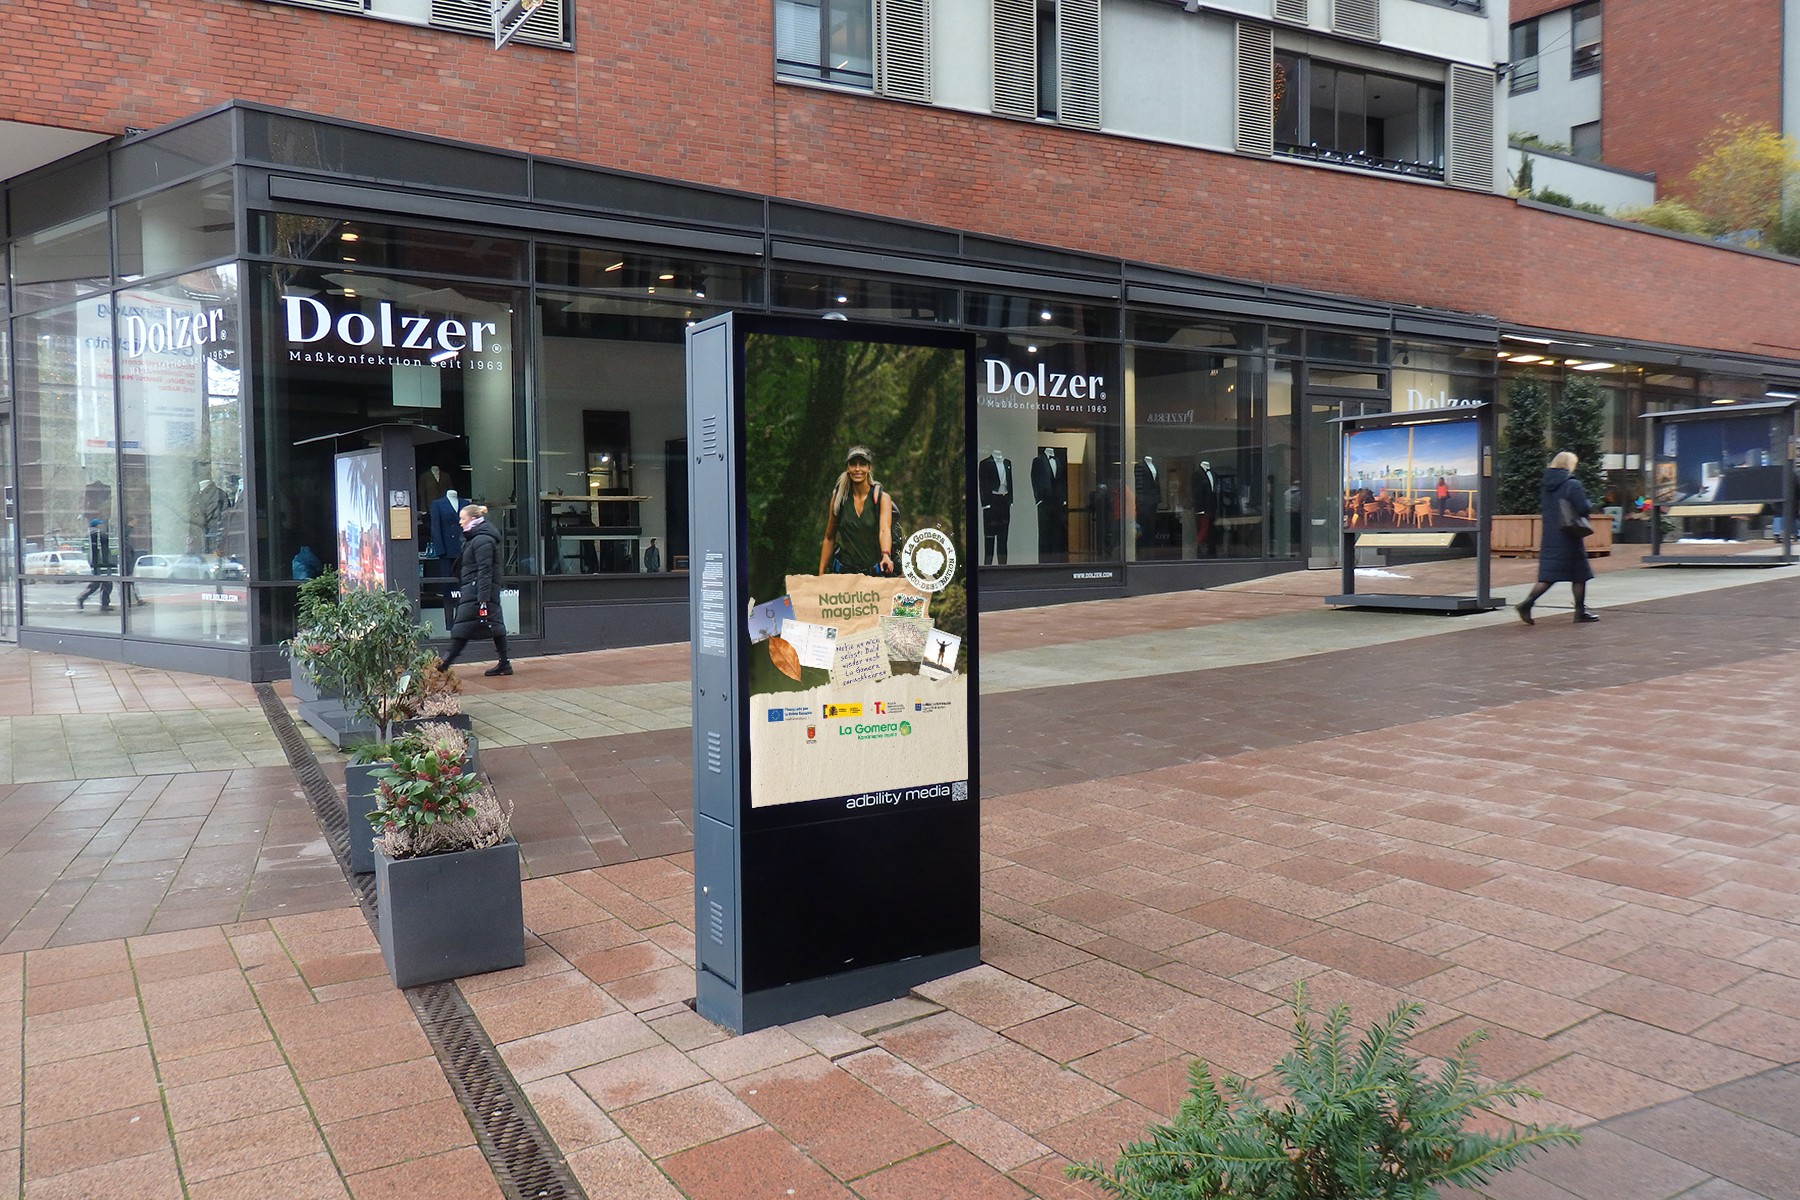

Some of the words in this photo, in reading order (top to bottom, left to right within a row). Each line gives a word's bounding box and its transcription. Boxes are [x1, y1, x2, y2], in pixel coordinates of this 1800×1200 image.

[209, 350, 228, 360] 1963
[289, 350, 422, 367] Maßkonfektion
[431, 357, 462, 369] seit
[470, 360, 503, 371] 1963
[987, 400, 1061, 411] Maßkonfektion
[1087, 405, 1107, 413] 1963
[818, 590, 880, 606] Natürlich
[821, 604, 879, 620] magisch
[839, 725, 852, 735] La
[855, 722, 897, 734] Gomera
[846, 791, 901, 809] adbility
[905, 785, 950, 800] media
